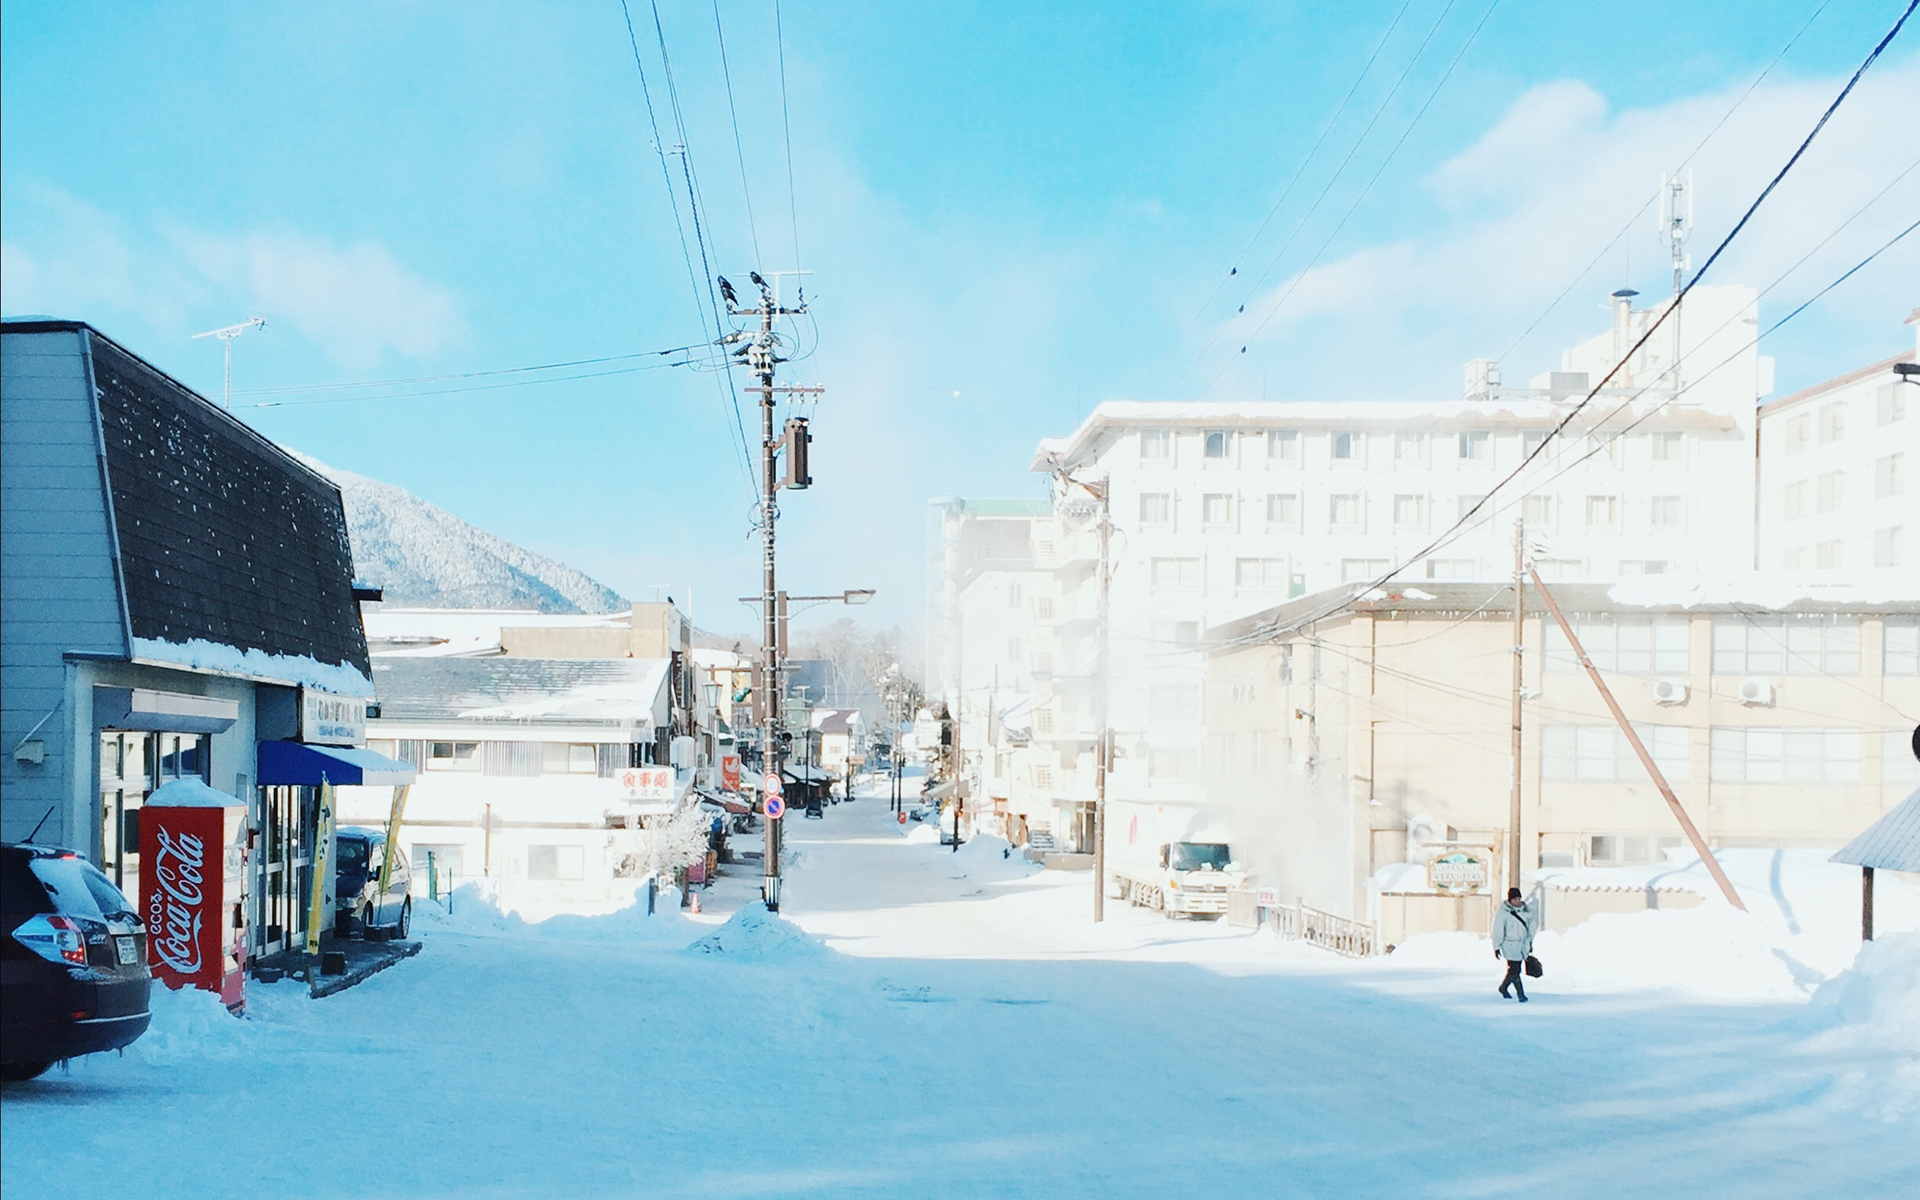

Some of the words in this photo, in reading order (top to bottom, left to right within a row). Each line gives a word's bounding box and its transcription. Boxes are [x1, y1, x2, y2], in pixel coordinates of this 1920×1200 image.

[622, 771, 668, 788] 食事処
[155, 823, 203, 974] Coca-Cola
